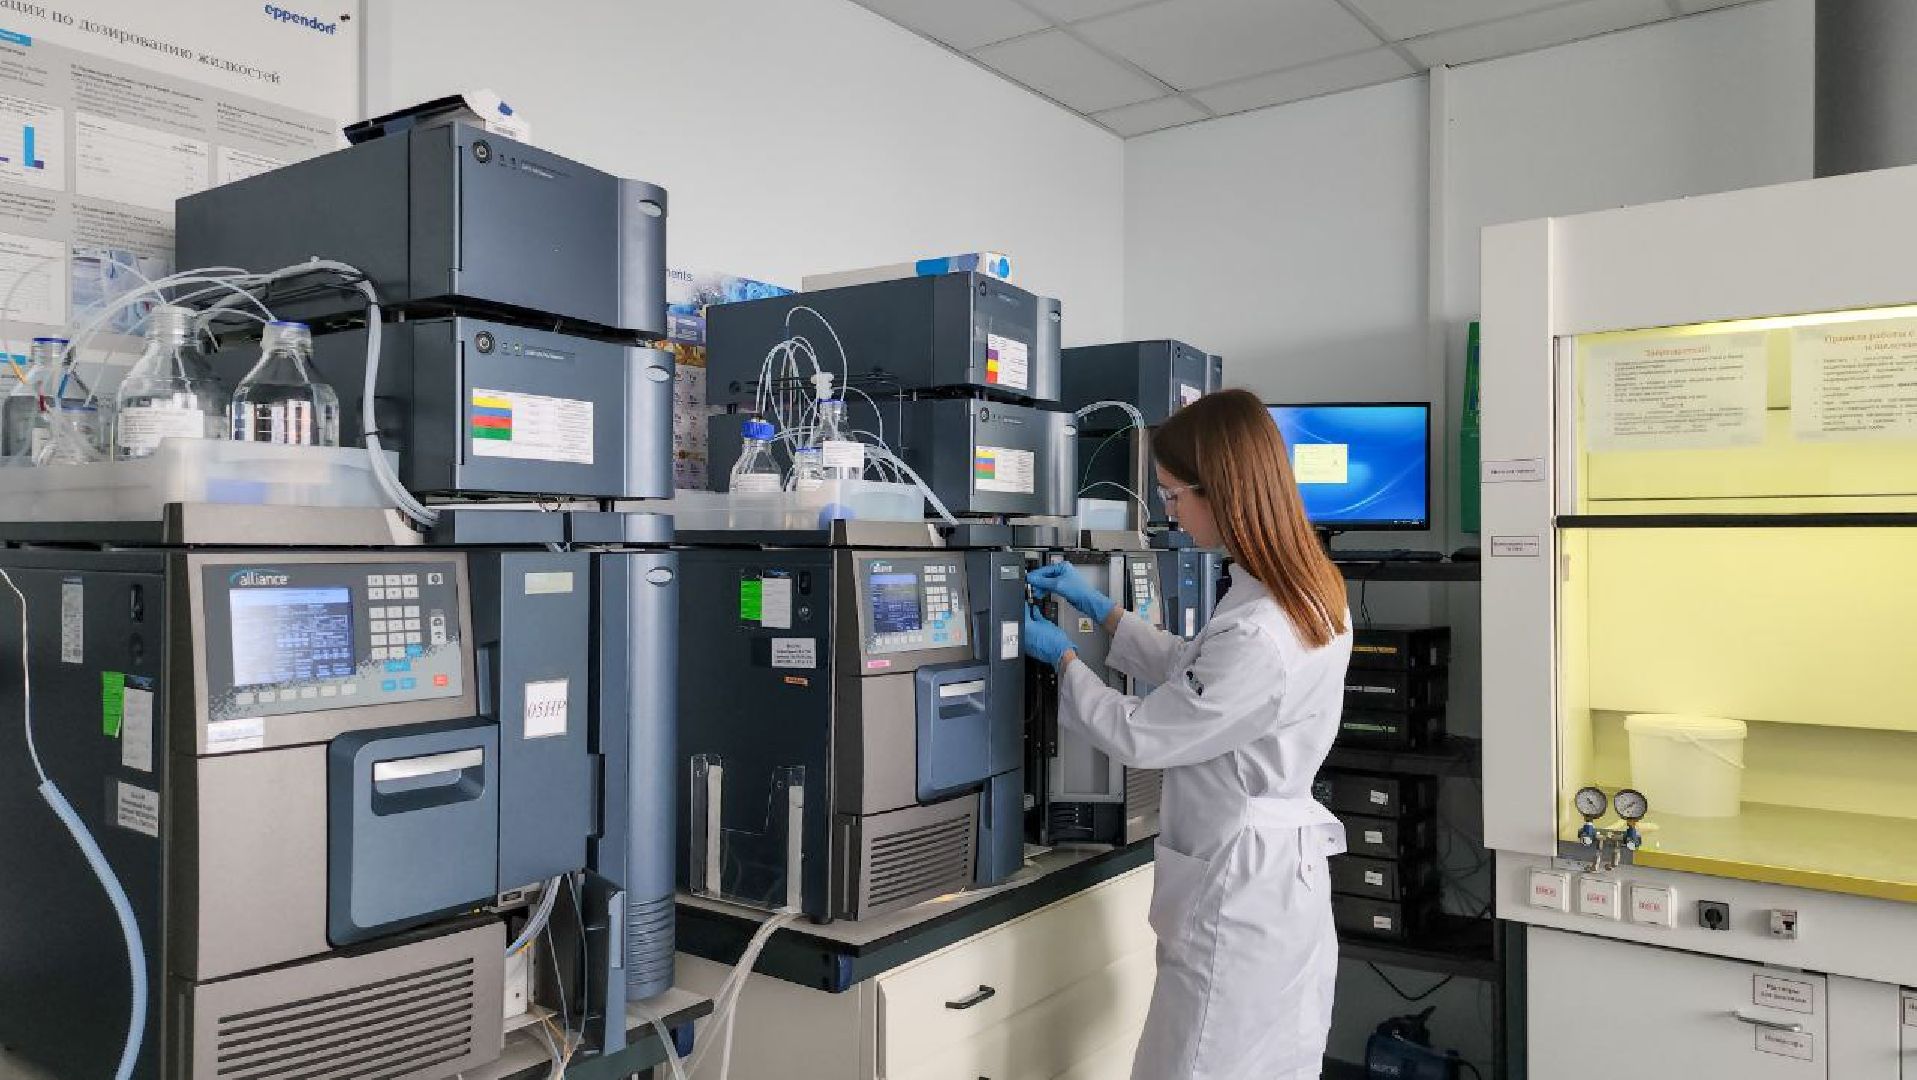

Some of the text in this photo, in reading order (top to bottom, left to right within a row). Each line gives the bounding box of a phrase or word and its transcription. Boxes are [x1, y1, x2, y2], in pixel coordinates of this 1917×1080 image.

[265, 3, 336, 35] eppendorf
[52, 10, 74, 25] по
[79, 19, 192, 60] дозированию
[198, 51, 281, 84] жидкостей
[239, 572, 288, 586] alliance
